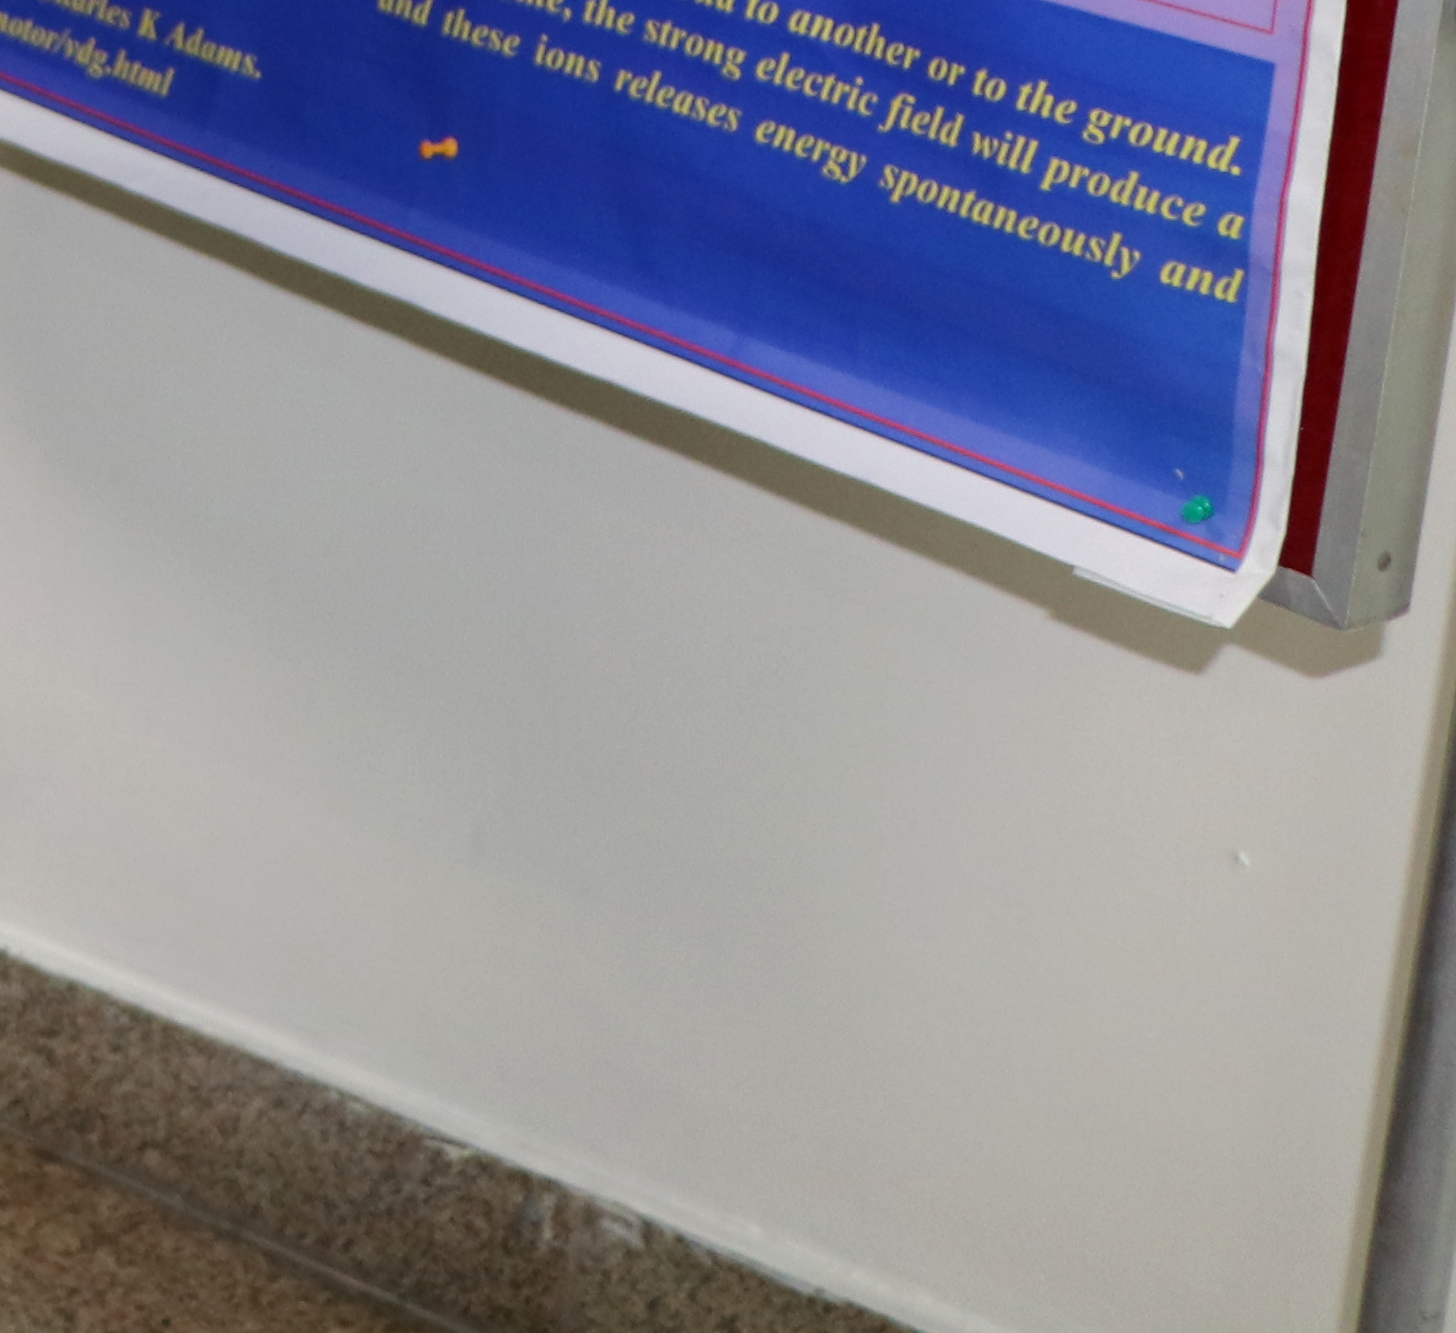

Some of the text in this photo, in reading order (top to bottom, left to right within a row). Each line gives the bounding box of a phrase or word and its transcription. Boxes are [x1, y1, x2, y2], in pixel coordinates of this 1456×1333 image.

[137, 8, 162, 40] K
[163, 21, 262, 79] Adams.
[788, 7, 922, 70] another
[928, 57, 965, 87] or
[974, 68, 1008, 102] to
[1015, 81, 1079, 124] the
[1083, 106, 1243, 177] ground.
